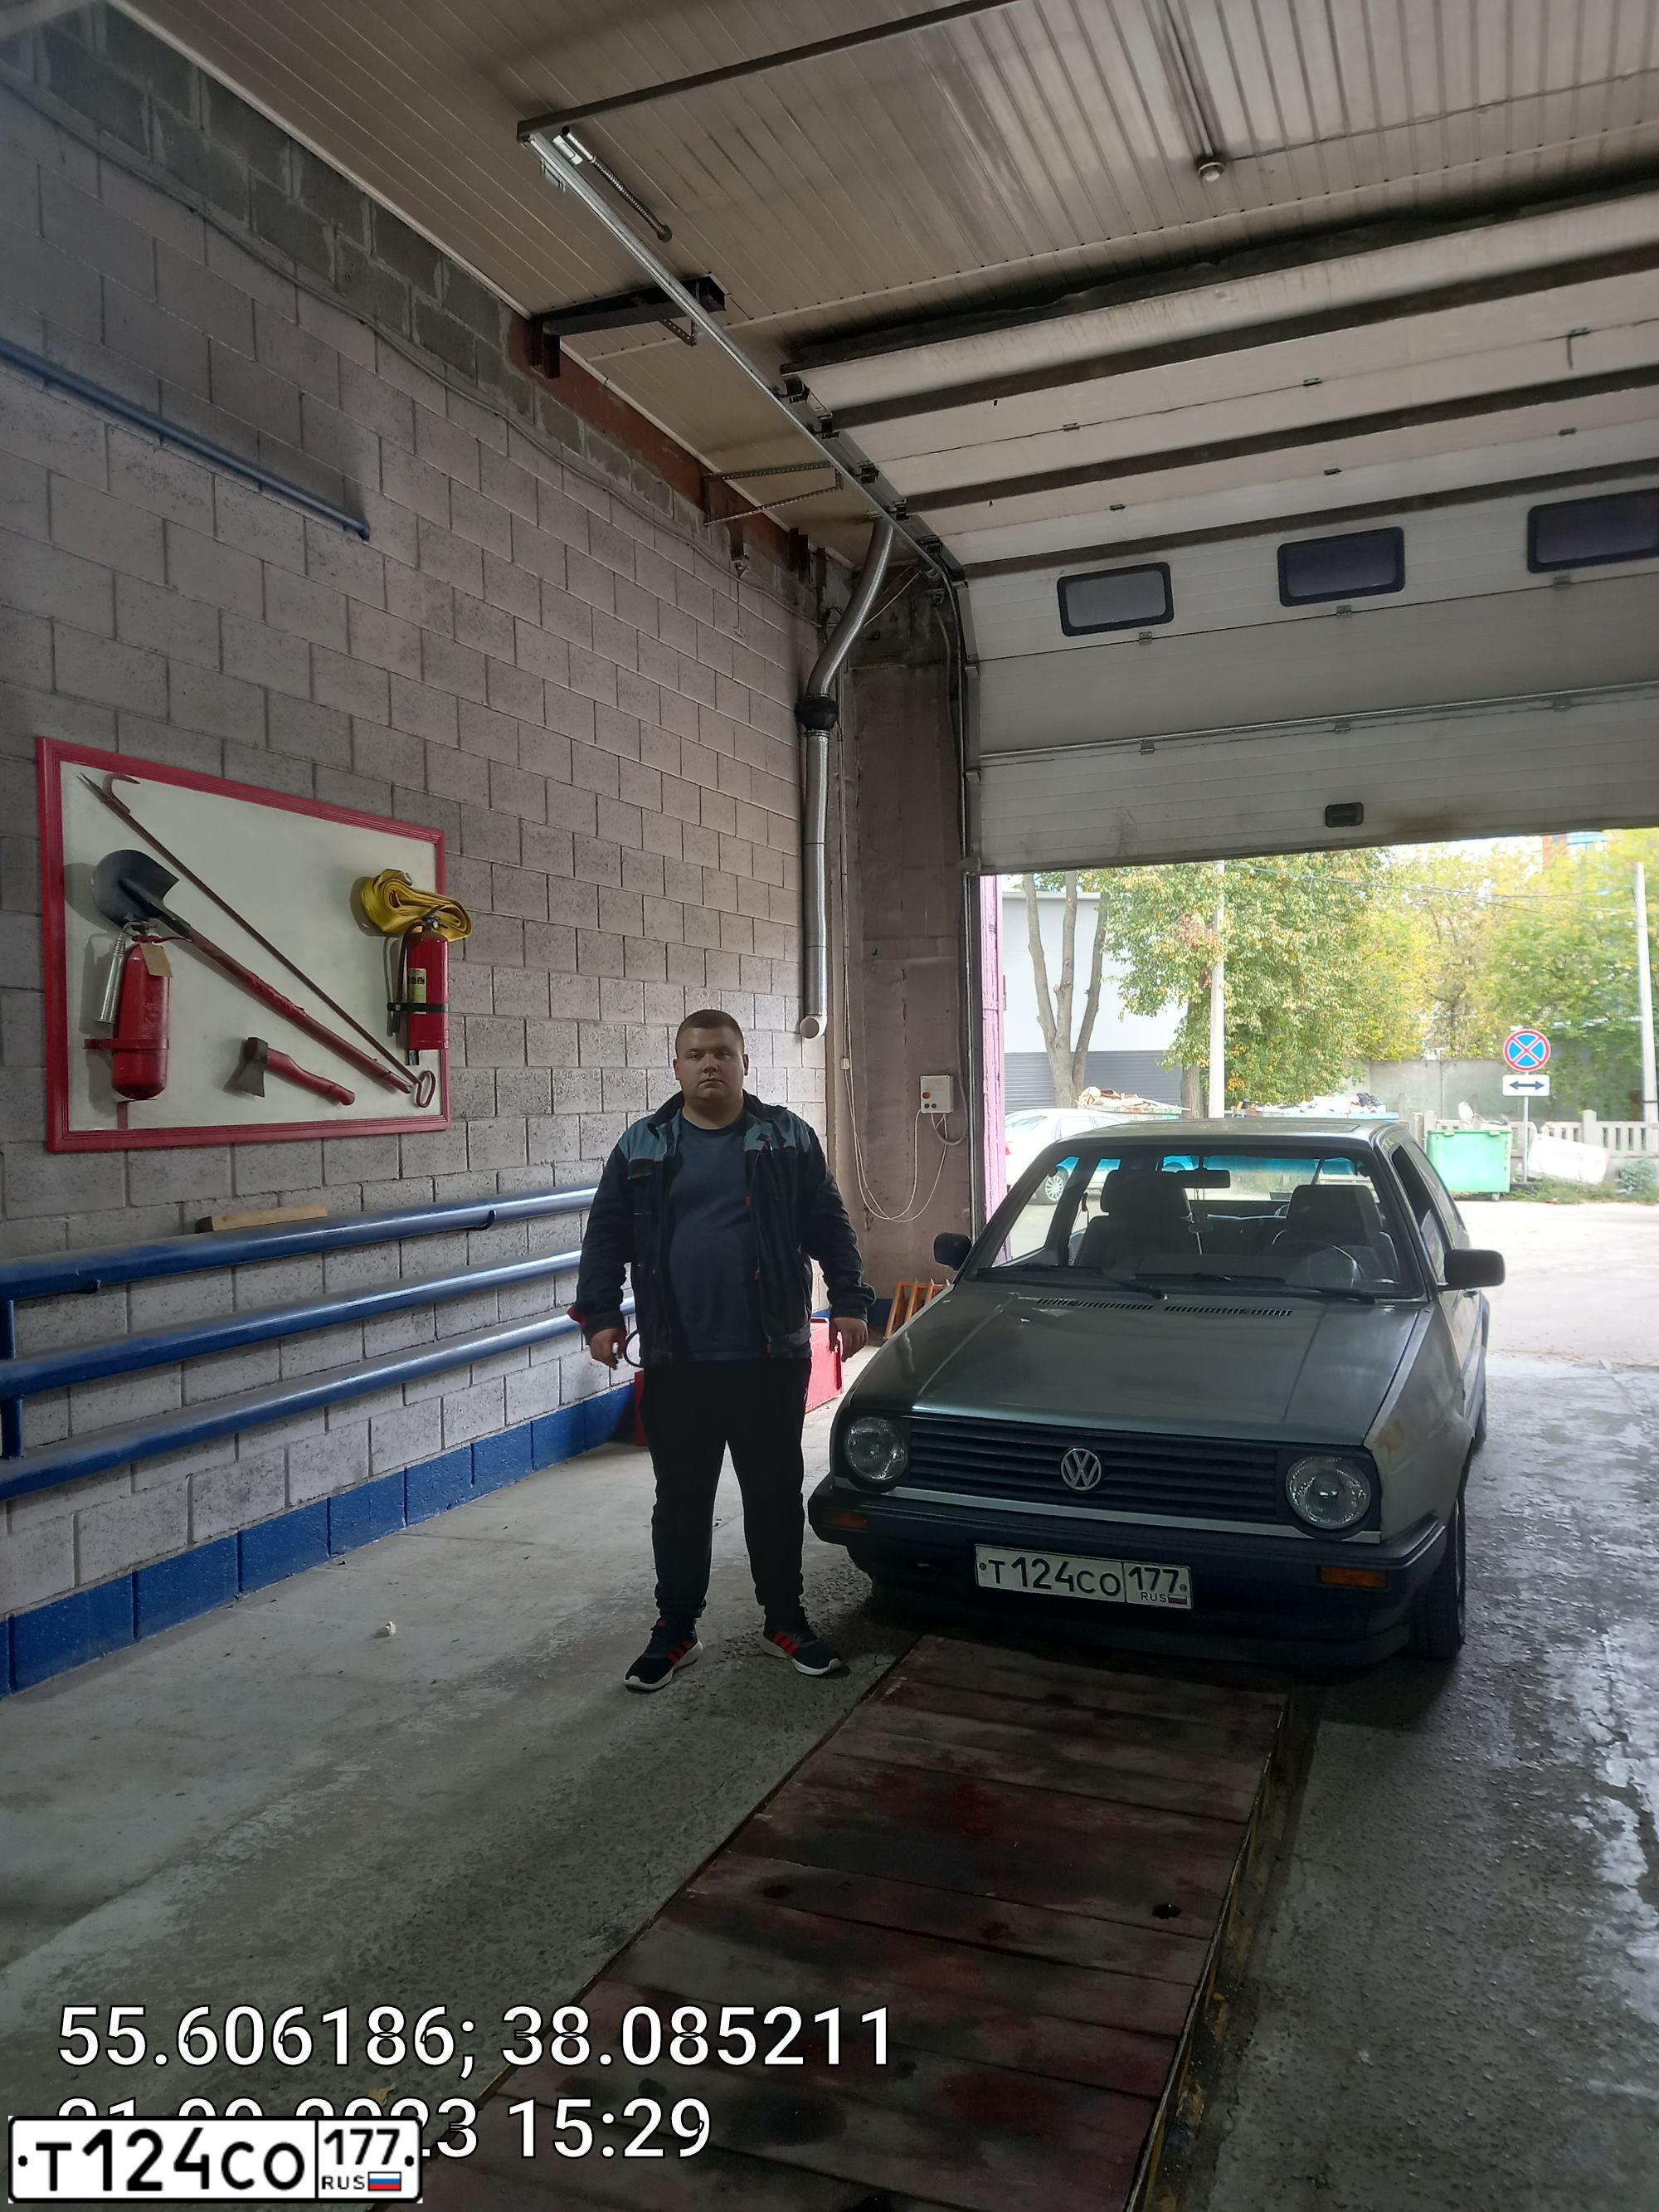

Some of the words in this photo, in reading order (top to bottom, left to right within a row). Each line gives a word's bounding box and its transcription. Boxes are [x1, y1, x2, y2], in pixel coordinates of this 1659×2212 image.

[988, 1556, 1121, 1596] Т124СО
[1128, 1566, 1180, 1593] 177
[1141, 1592, 1167, 1603] RUS
